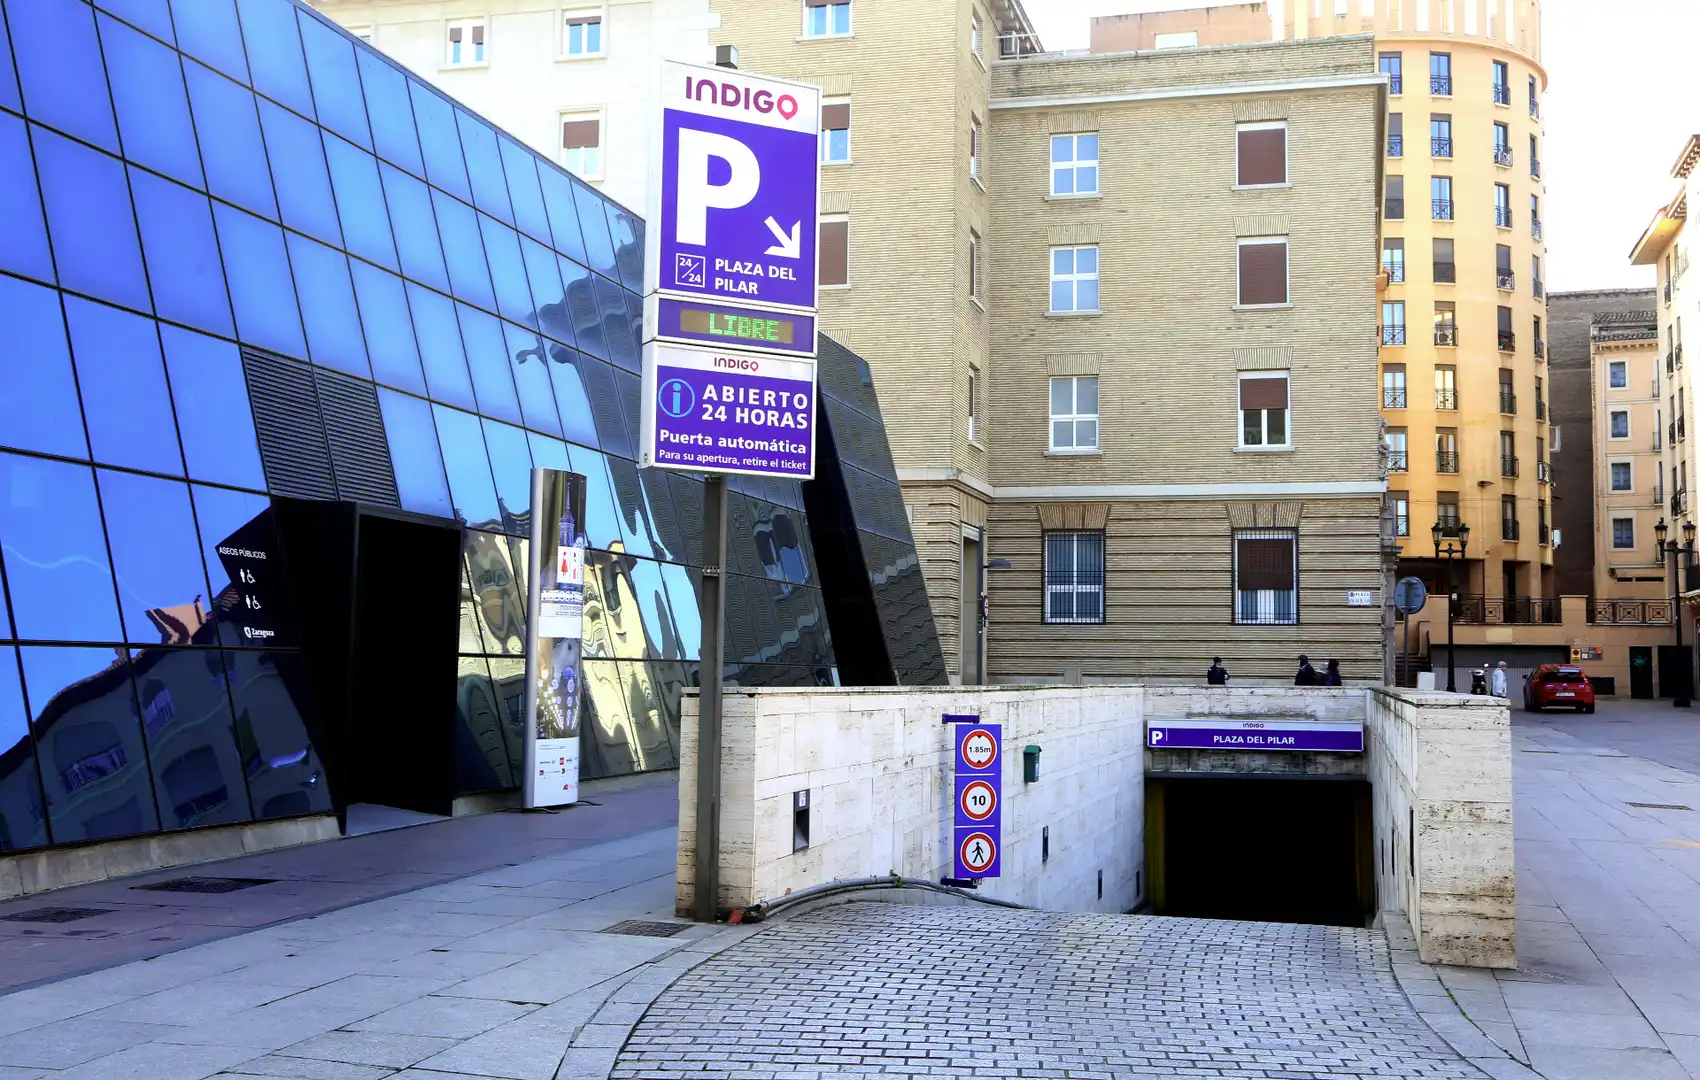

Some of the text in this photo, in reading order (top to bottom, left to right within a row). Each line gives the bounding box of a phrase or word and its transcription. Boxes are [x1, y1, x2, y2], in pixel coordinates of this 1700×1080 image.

[685, 76, 798, 120] INDIGO
[676, 127, 761, 247] P
[715, 258, 797, 281] PLAZA DEL
[714, 277, 759, 295] PILAR
[709, 312, 780, 341] LIBRE
[714, 357, 759, 372] INDIGO
[702, 384, 808, 410] ABIERTO
[701, 404, 808, 429] 24 HORAS
[660, 429, 806, 454] Puerta automática
[659, 449, 681, 460] Para
[683, 453, 694, 461] su
[696, 454, 740, 465] apertura,
[743, 457, 768, 467] retire
[770, 458, 779, 468] el
[781, 459, 806, 470] ticket
[219, 546, 267, 560] ASEOS PÚBLICOS
[251, 627, 275, 638] Zaragoza
[1151, 730, 1163, 745] P
[1213, 735, 1295, 745] PLAZA DEL PILAR
[971, 795, 986, 806] 10
